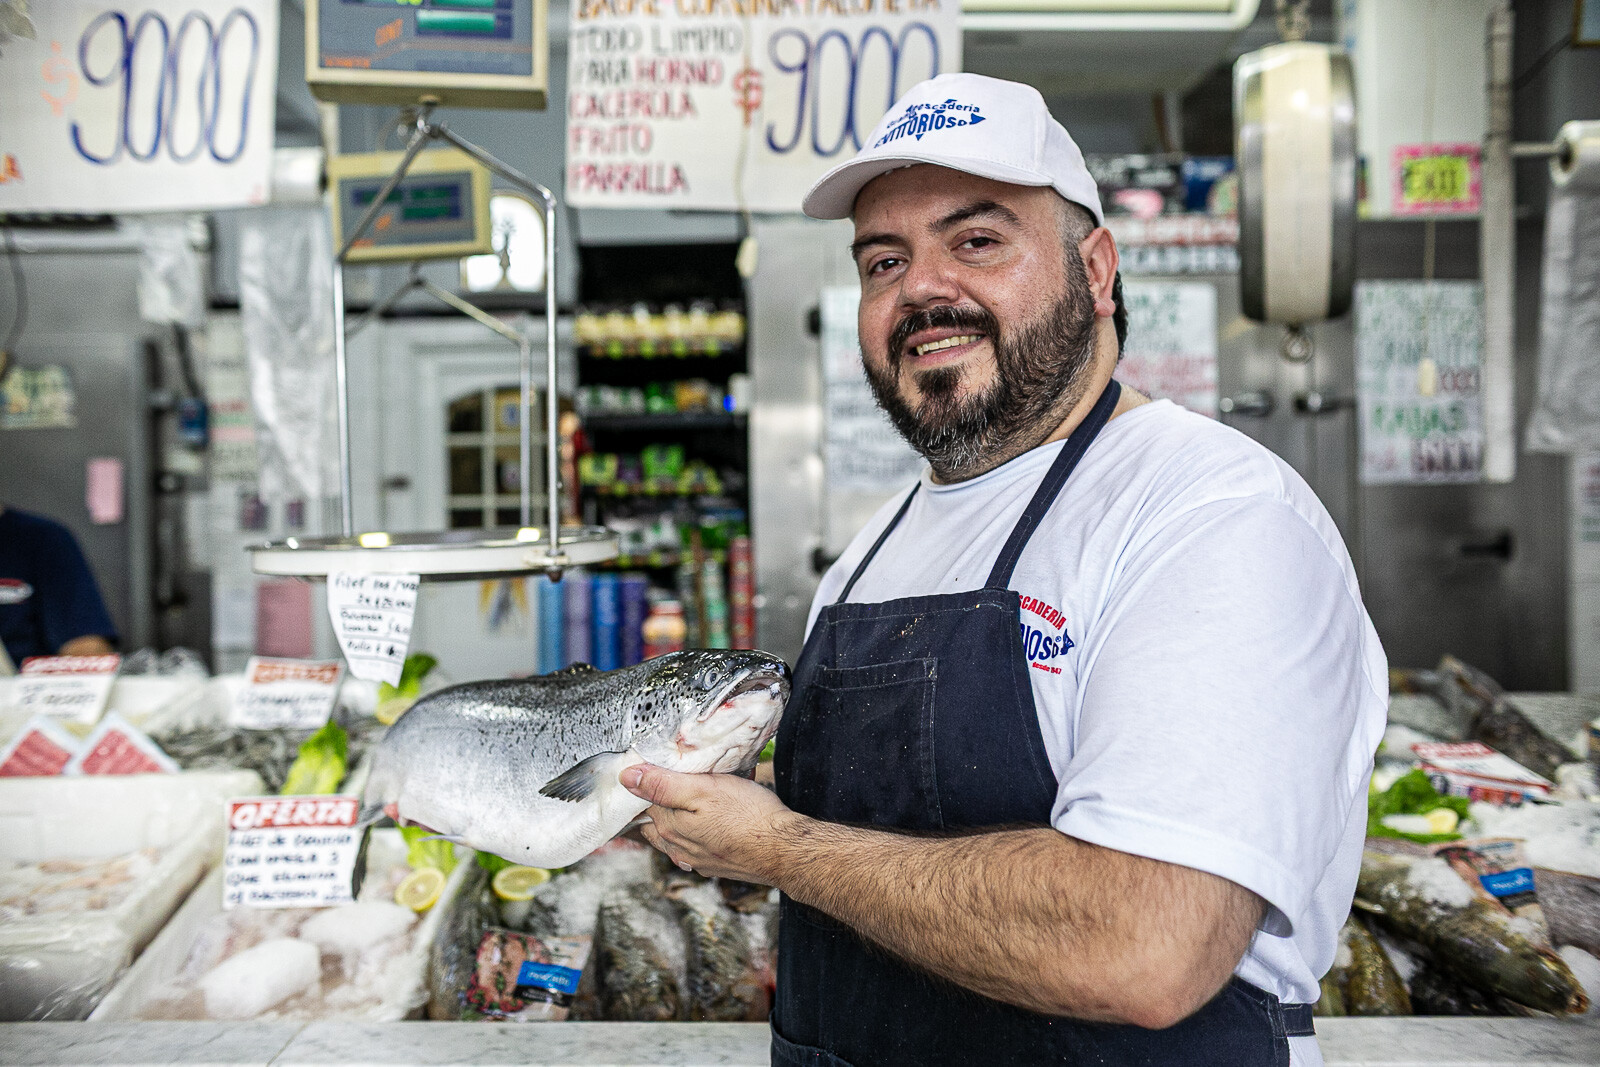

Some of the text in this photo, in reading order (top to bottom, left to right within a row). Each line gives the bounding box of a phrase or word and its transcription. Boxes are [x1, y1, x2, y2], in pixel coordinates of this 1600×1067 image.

[633, 56, 724, 84] HORNO
[70, 8, 260, 166] 9000
[568, 90, 698, 118] CACEROLA
[568, 124, 653, 155] FRITO
[567, 162, 692, 194] PARRILLA
[230, 801, 355, 829] OFERTA
